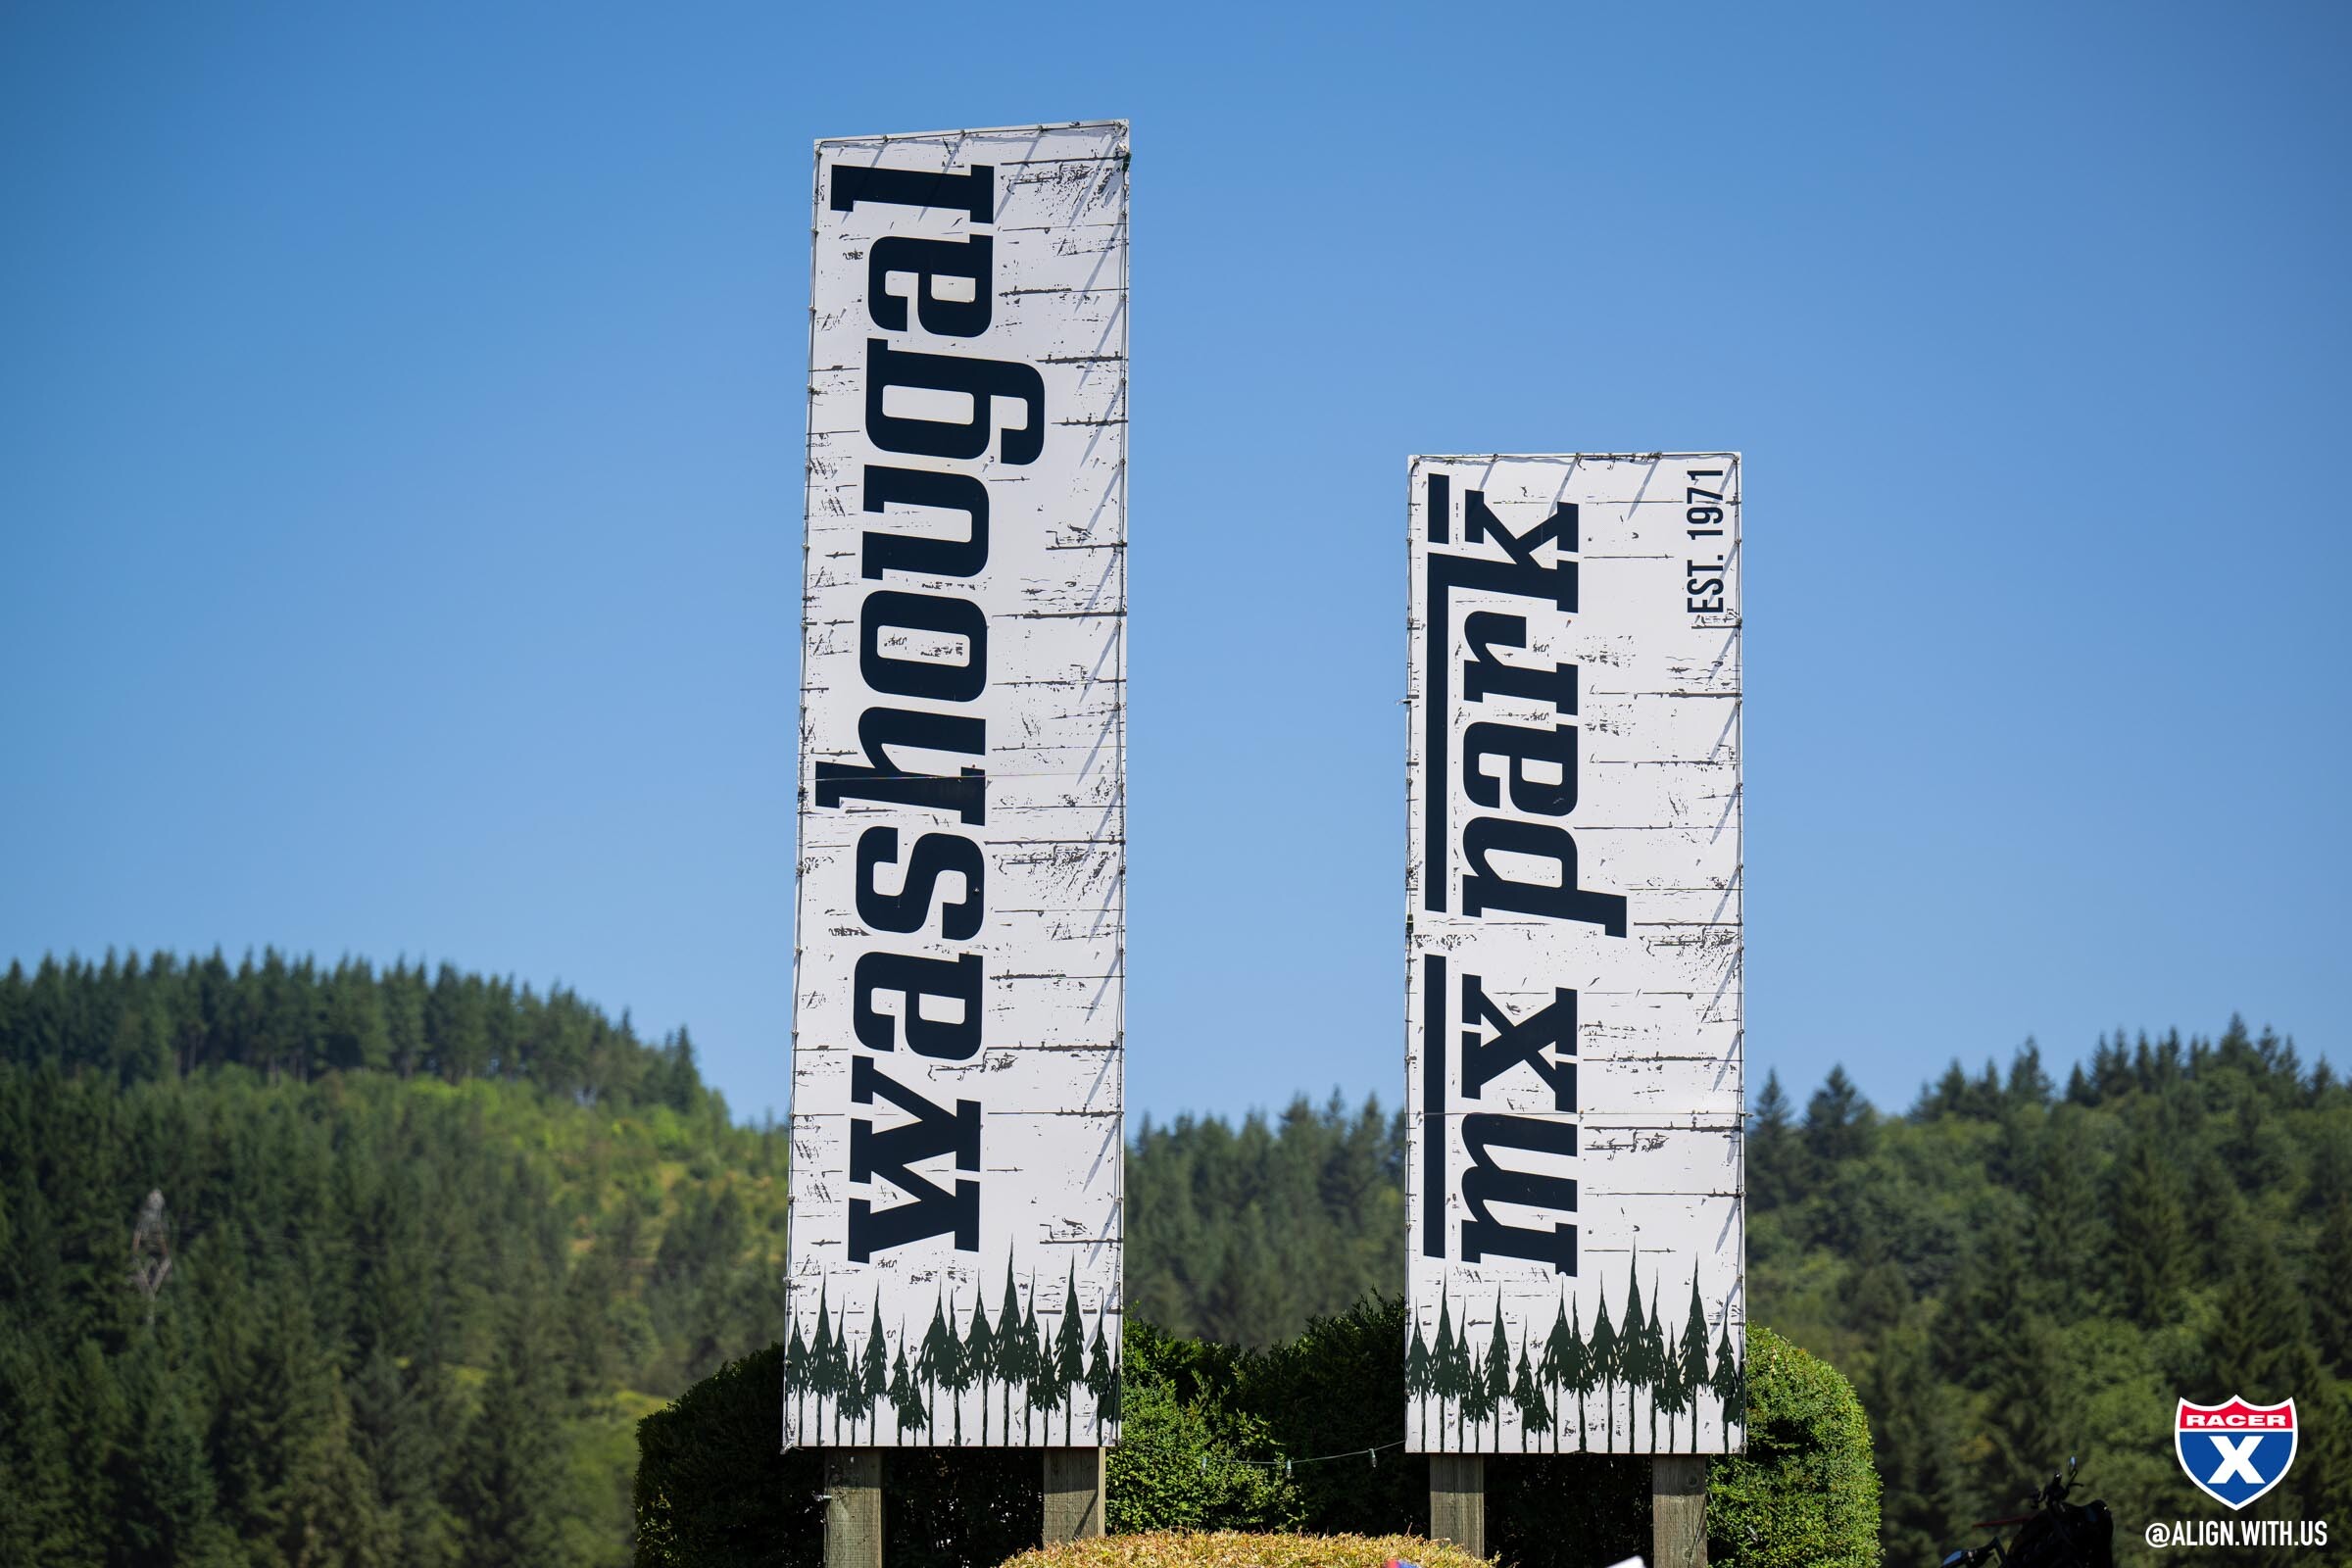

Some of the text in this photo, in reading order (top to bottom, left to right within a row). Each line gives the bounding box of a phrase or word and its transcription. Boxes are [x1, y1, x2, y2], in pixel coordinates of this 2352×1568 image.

[815, 164, 1045, 1264] washougal
[1426, 489, 1628, 1278] mx park
[1686, 469, 1725, 614] EST. 1971
